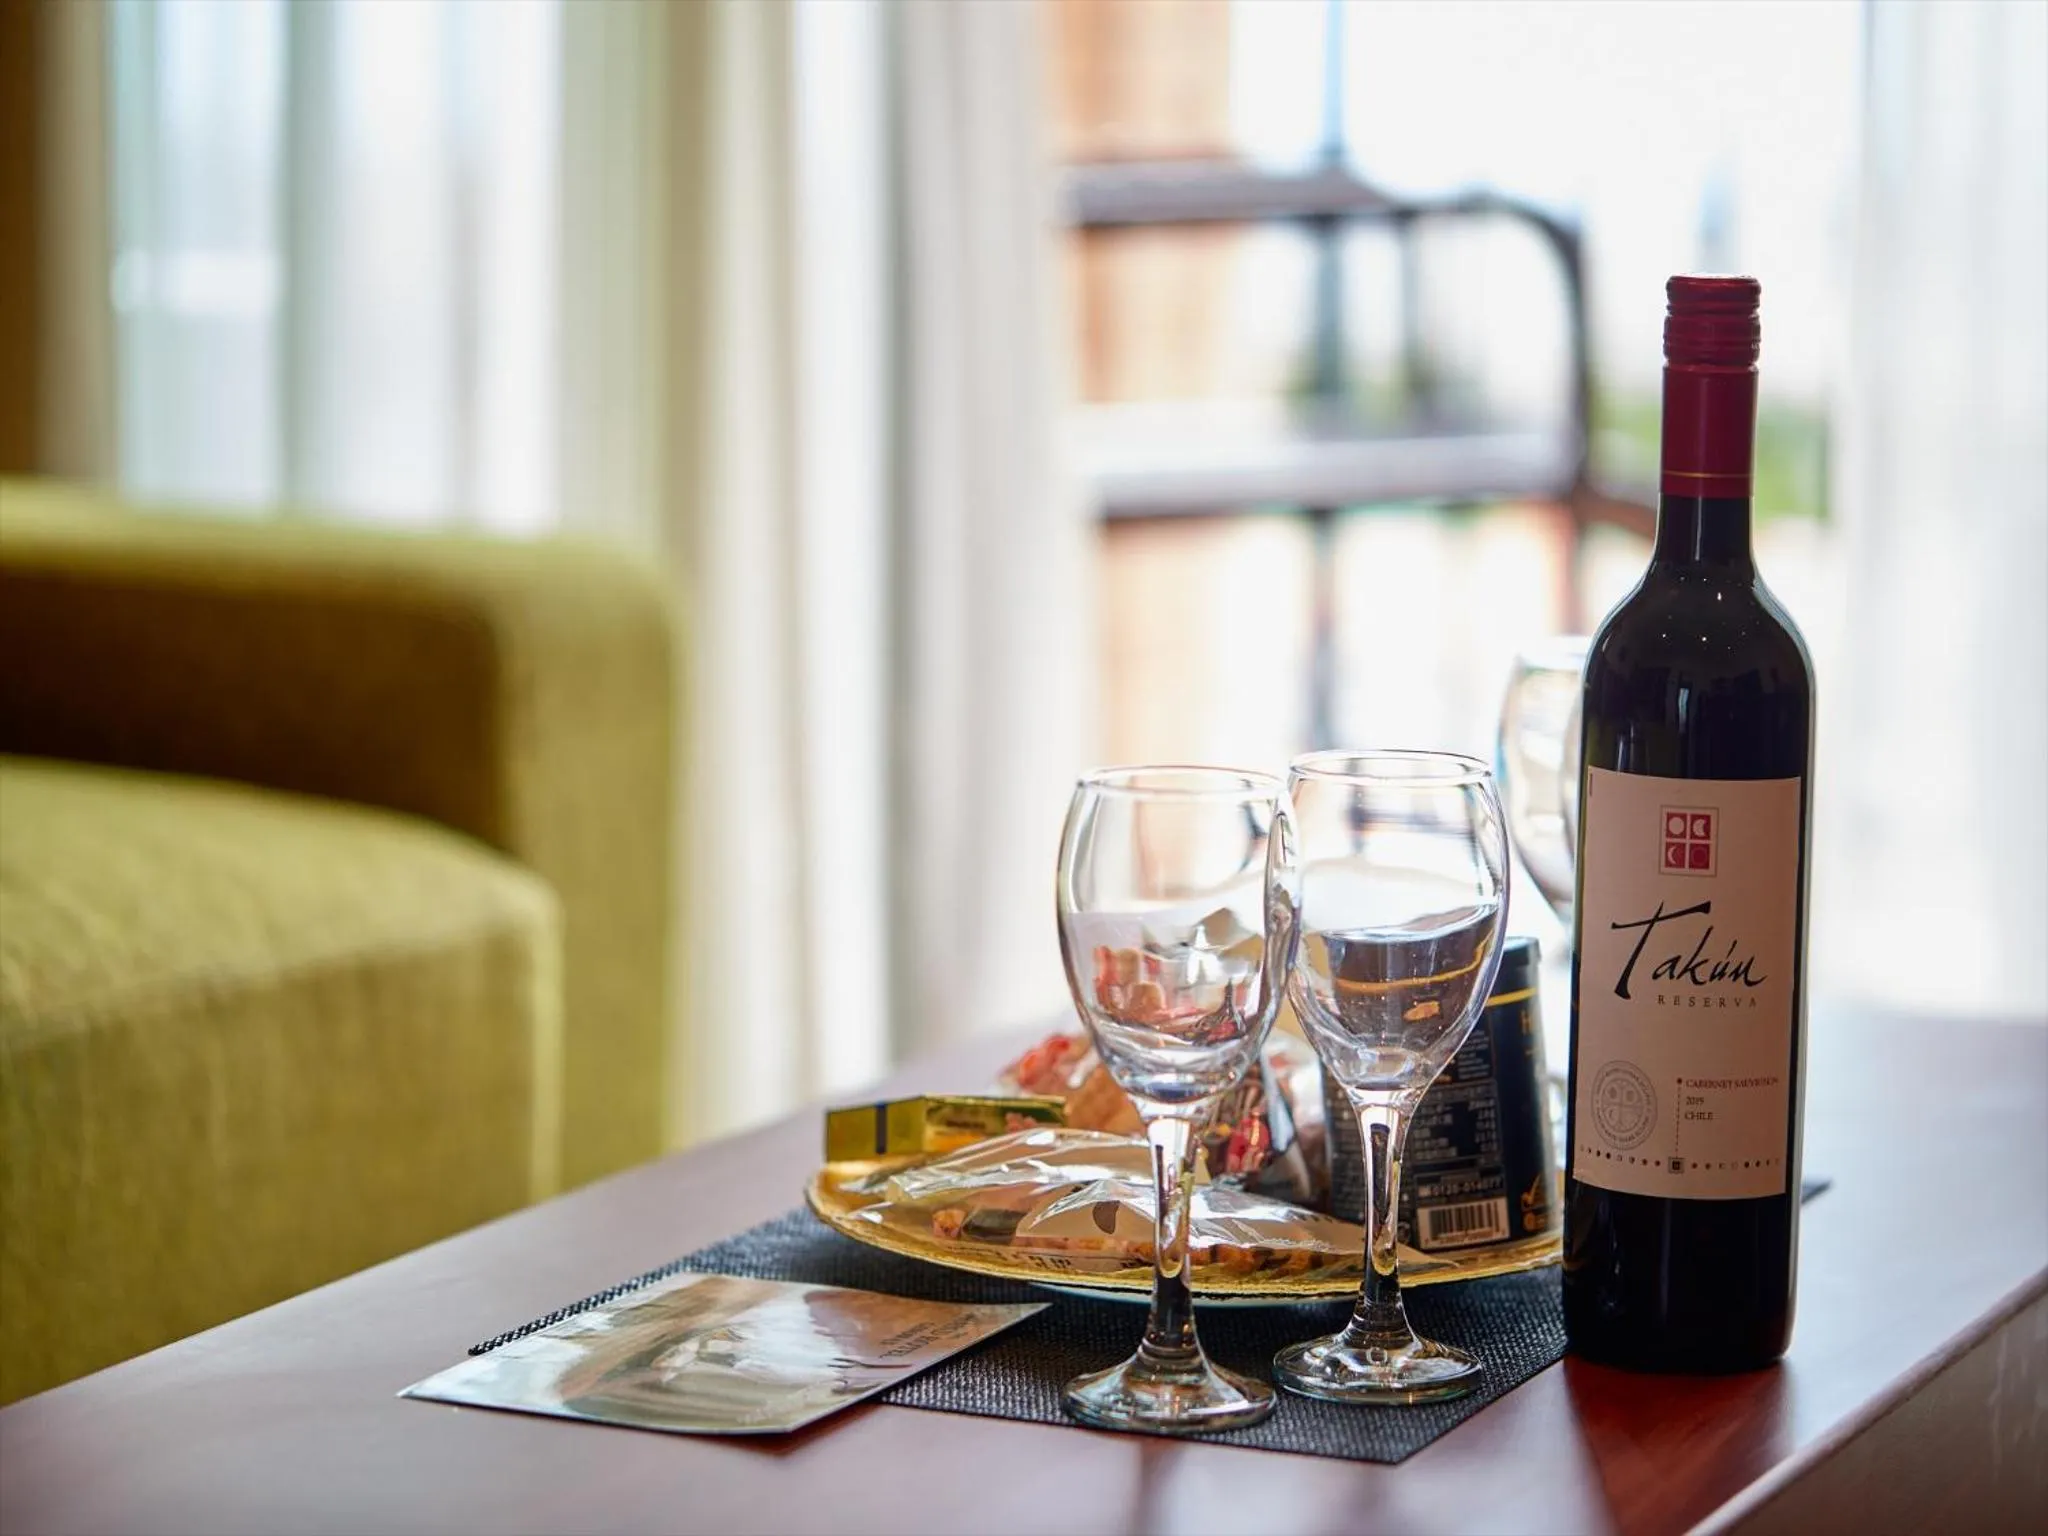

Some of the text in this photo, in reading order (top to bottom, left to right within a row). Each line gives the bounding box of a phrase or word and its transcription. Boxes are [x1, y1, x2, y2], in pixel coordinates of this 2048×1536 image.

[1611, 899, 1768, 1000] Takún
[1657, 994, 1757, 1009] RESERVA
[1685, 1078, 1733, 1090] CABERNET
[1684, 1112, 1714, 1121] CHILE
